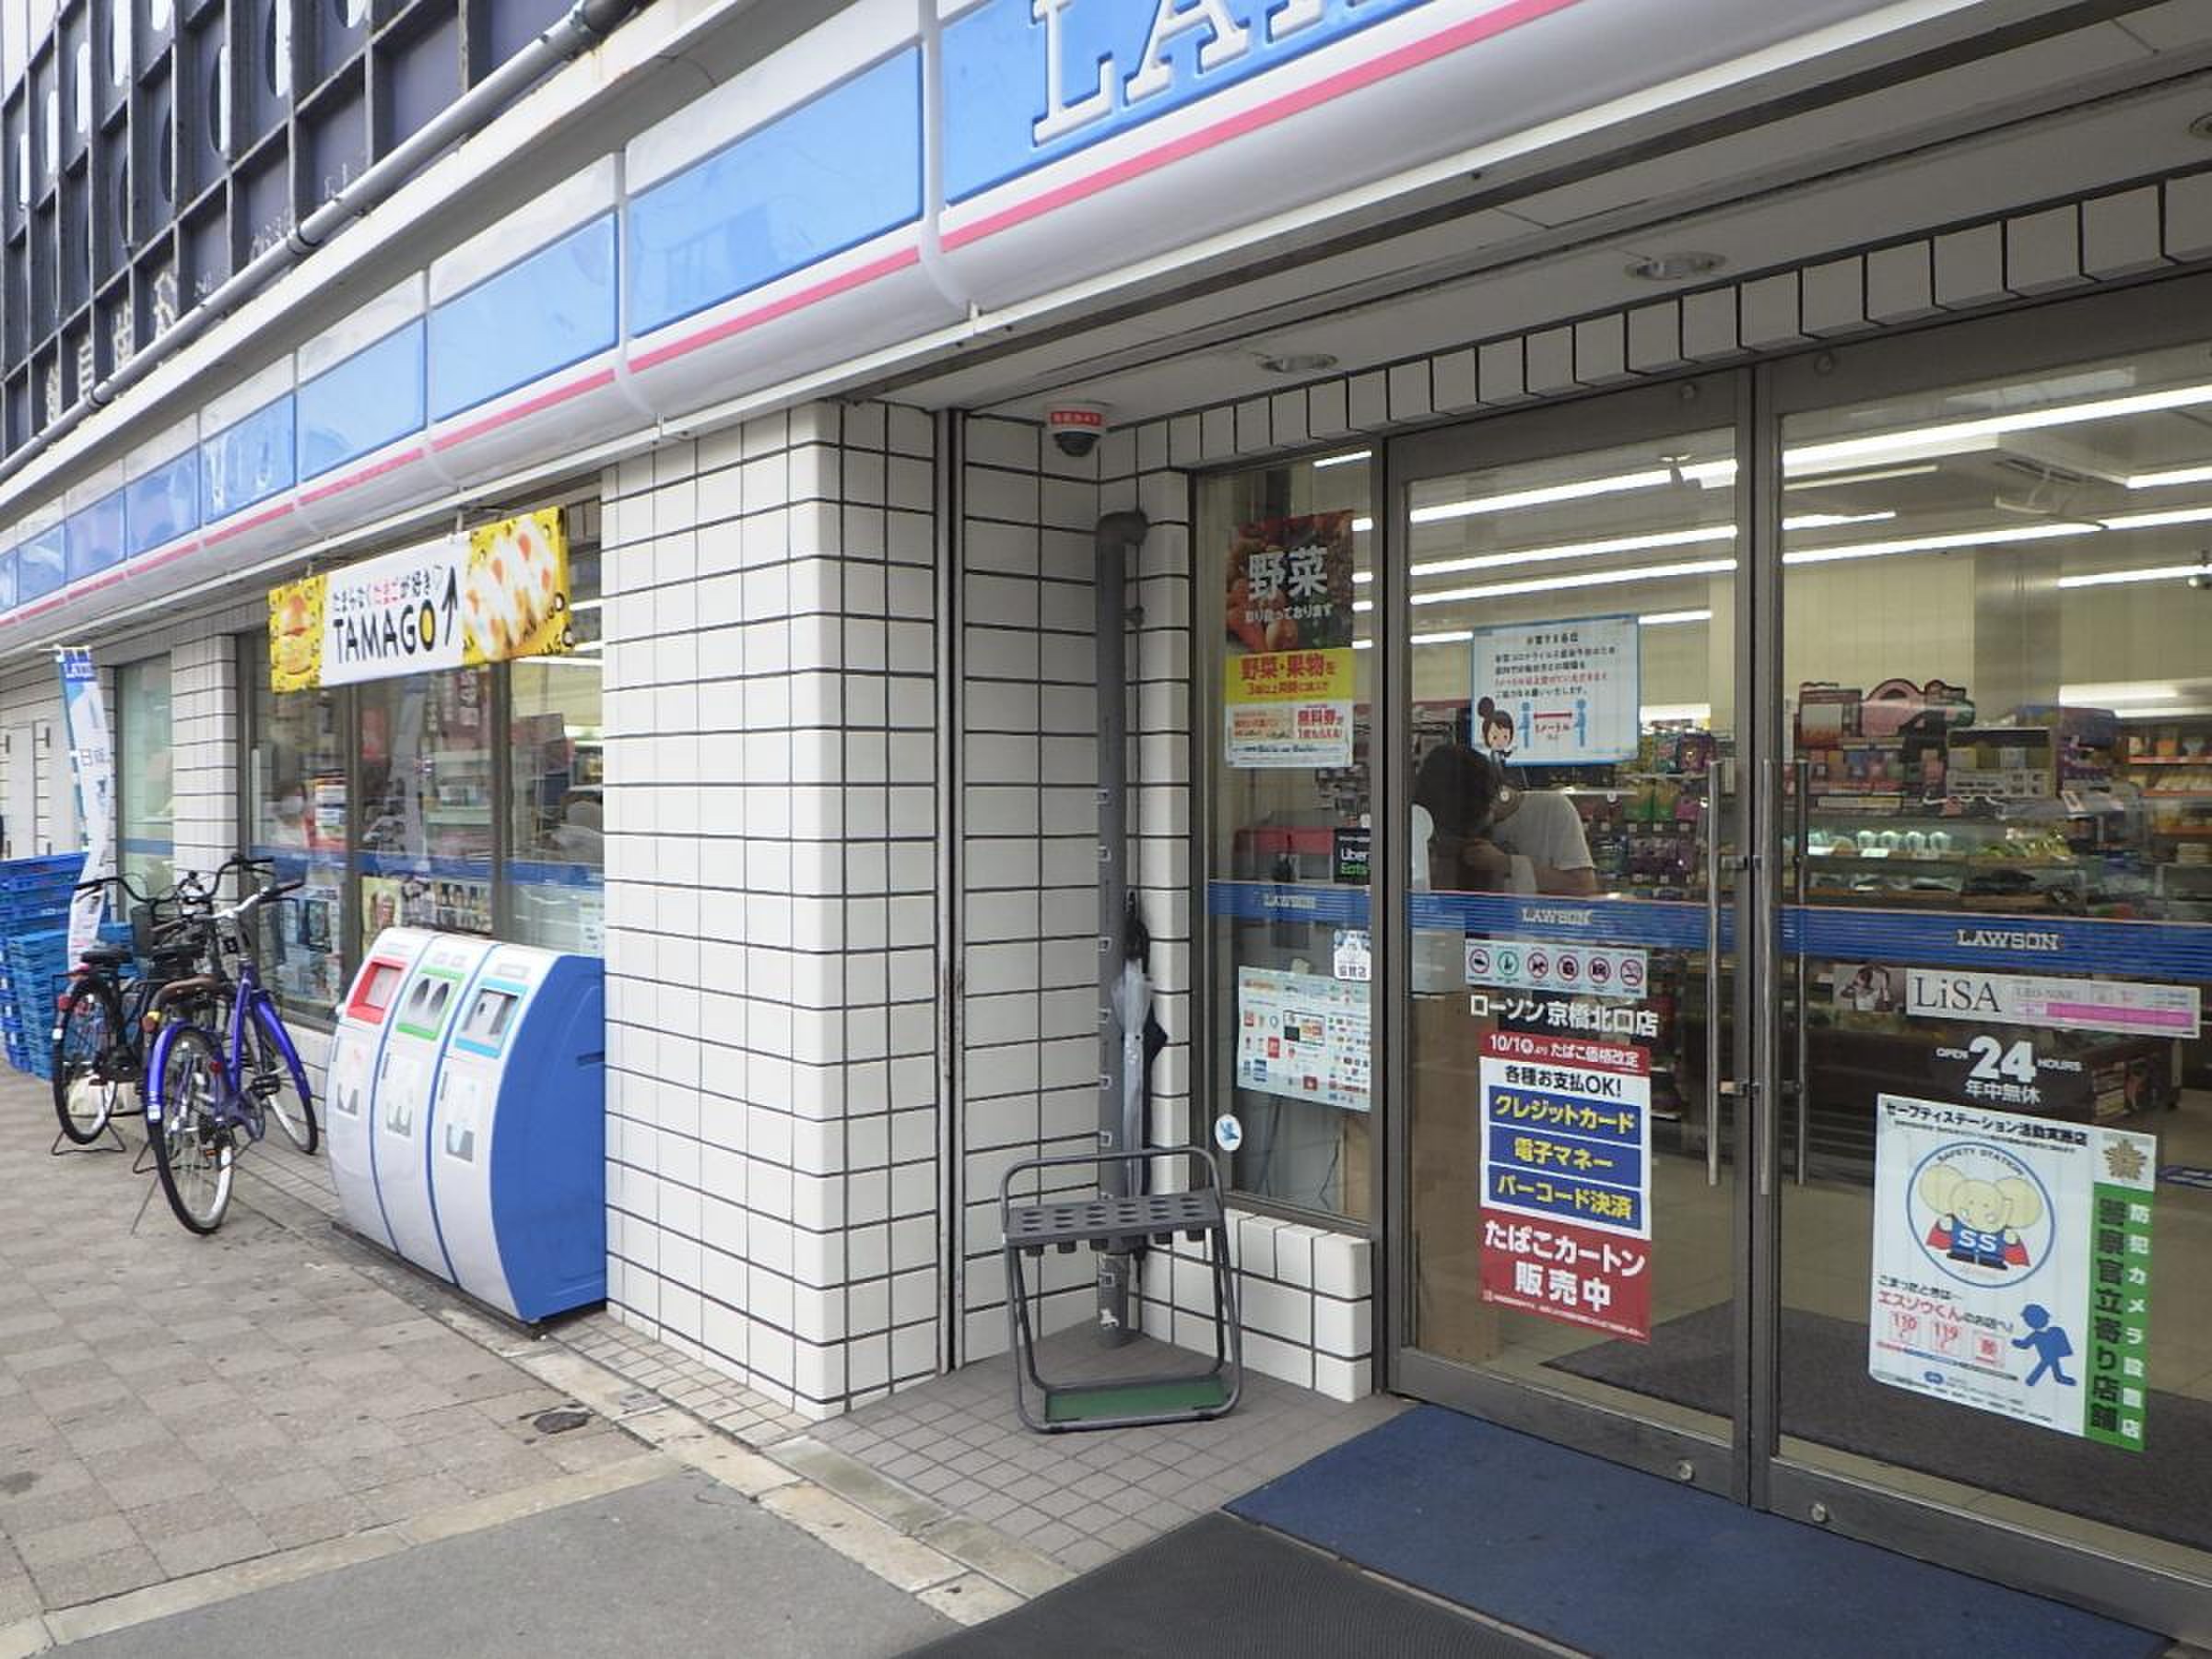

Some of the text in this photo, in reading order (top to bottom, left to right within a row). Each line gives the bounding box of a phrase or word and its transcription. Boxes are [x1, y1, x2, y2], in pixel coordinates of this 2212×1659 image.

[1249, 546, 1328, 601] 野菜
[333, 599, 435, 665] TAMAGO
[1341, 847, 1371, 862] Uber
[1521, 906, 1594, 926] LAWSON
[1956, 929, 2061, 950] LAWSON
[1913, 977, 2002, 1013] LiSA
[1470, 994, 1660, 1038] ローソン 京橋北口店
[1968, 1035, 2036, 1083] 24
[2037, 1058, 2082, 1073] HOURS
[1505, 1065, 1622, 1098] 各種お支払OK!
[1964, 1079, 2041, 1104] 年中無休
[1495, 1095, 1634, 1135] クレジットカード
[1514, 1136, 1614, 1171] 電子マネー
[1498, 1174, 1633, 1221] バーコード決済
[1485, 1219, 1646, 1277] たばこカートン
[1959, 1230, 1998, 1253] SS
[1514, 1260, 1612, 1313] 販売中
